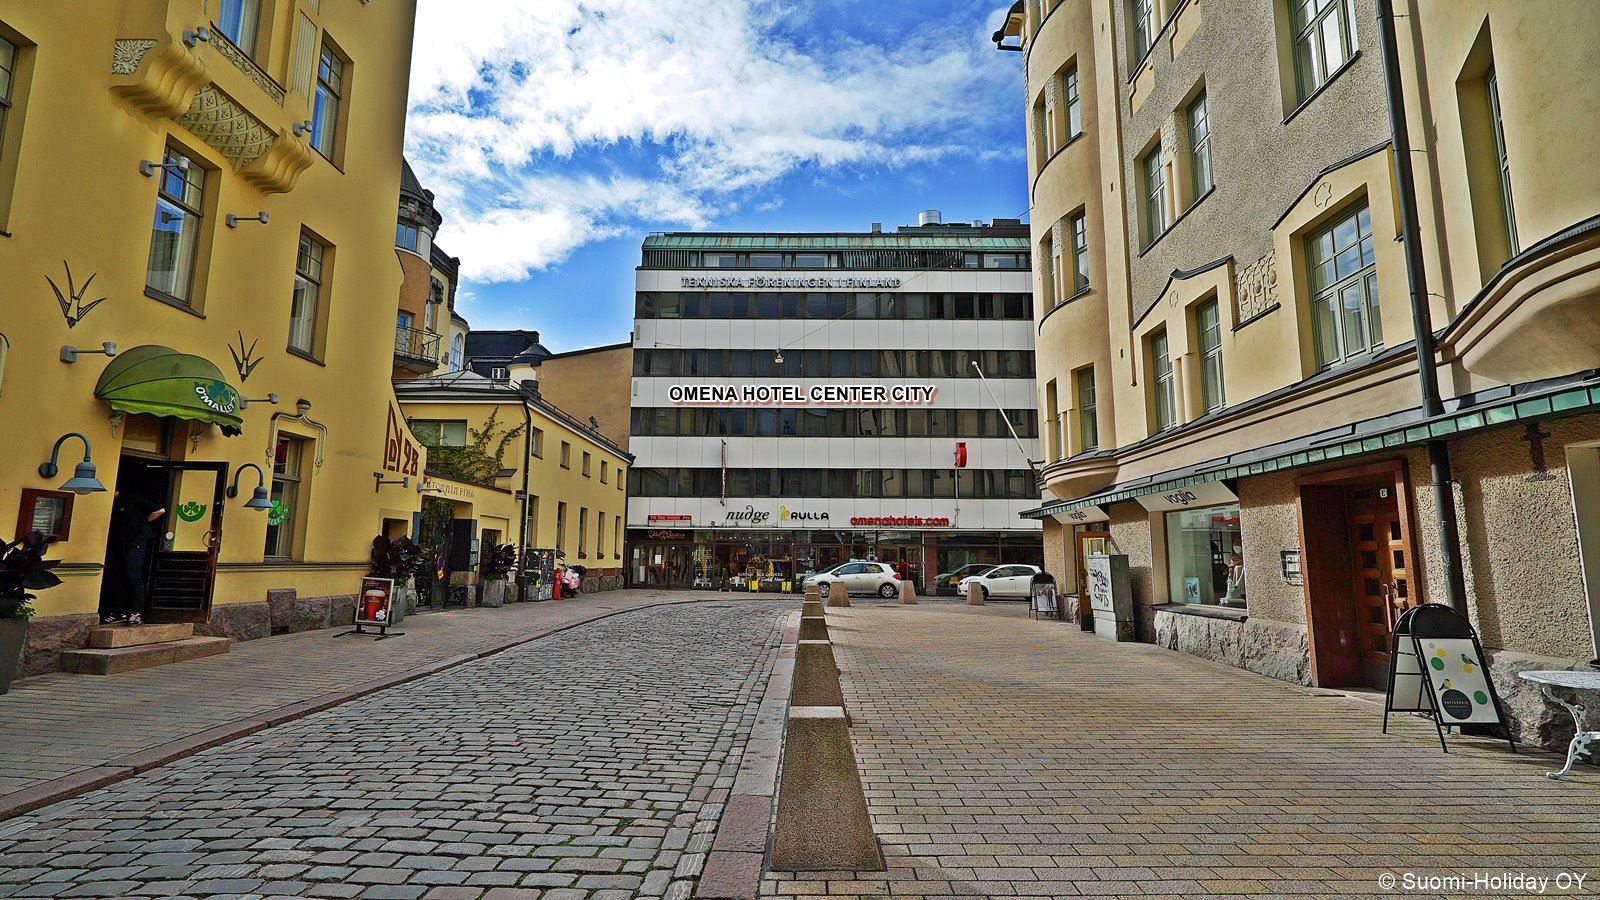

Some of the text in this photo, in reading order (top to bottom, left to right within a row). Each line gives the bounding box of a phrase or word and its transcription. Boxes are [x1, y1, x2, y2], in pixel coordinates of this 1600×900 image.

[681, 277, 745, 288] TEKNISKA
[748, 276, 833, 288] FÖRENINGEN
[846, 277, 902, 288] FINLAND
[1163, 489, 1198, 506] voglia
[726, 505, 770, 524] nudge
[790, 511, 830, 520] RULLA
[850, 515, 950, 526] omenahotels.com
